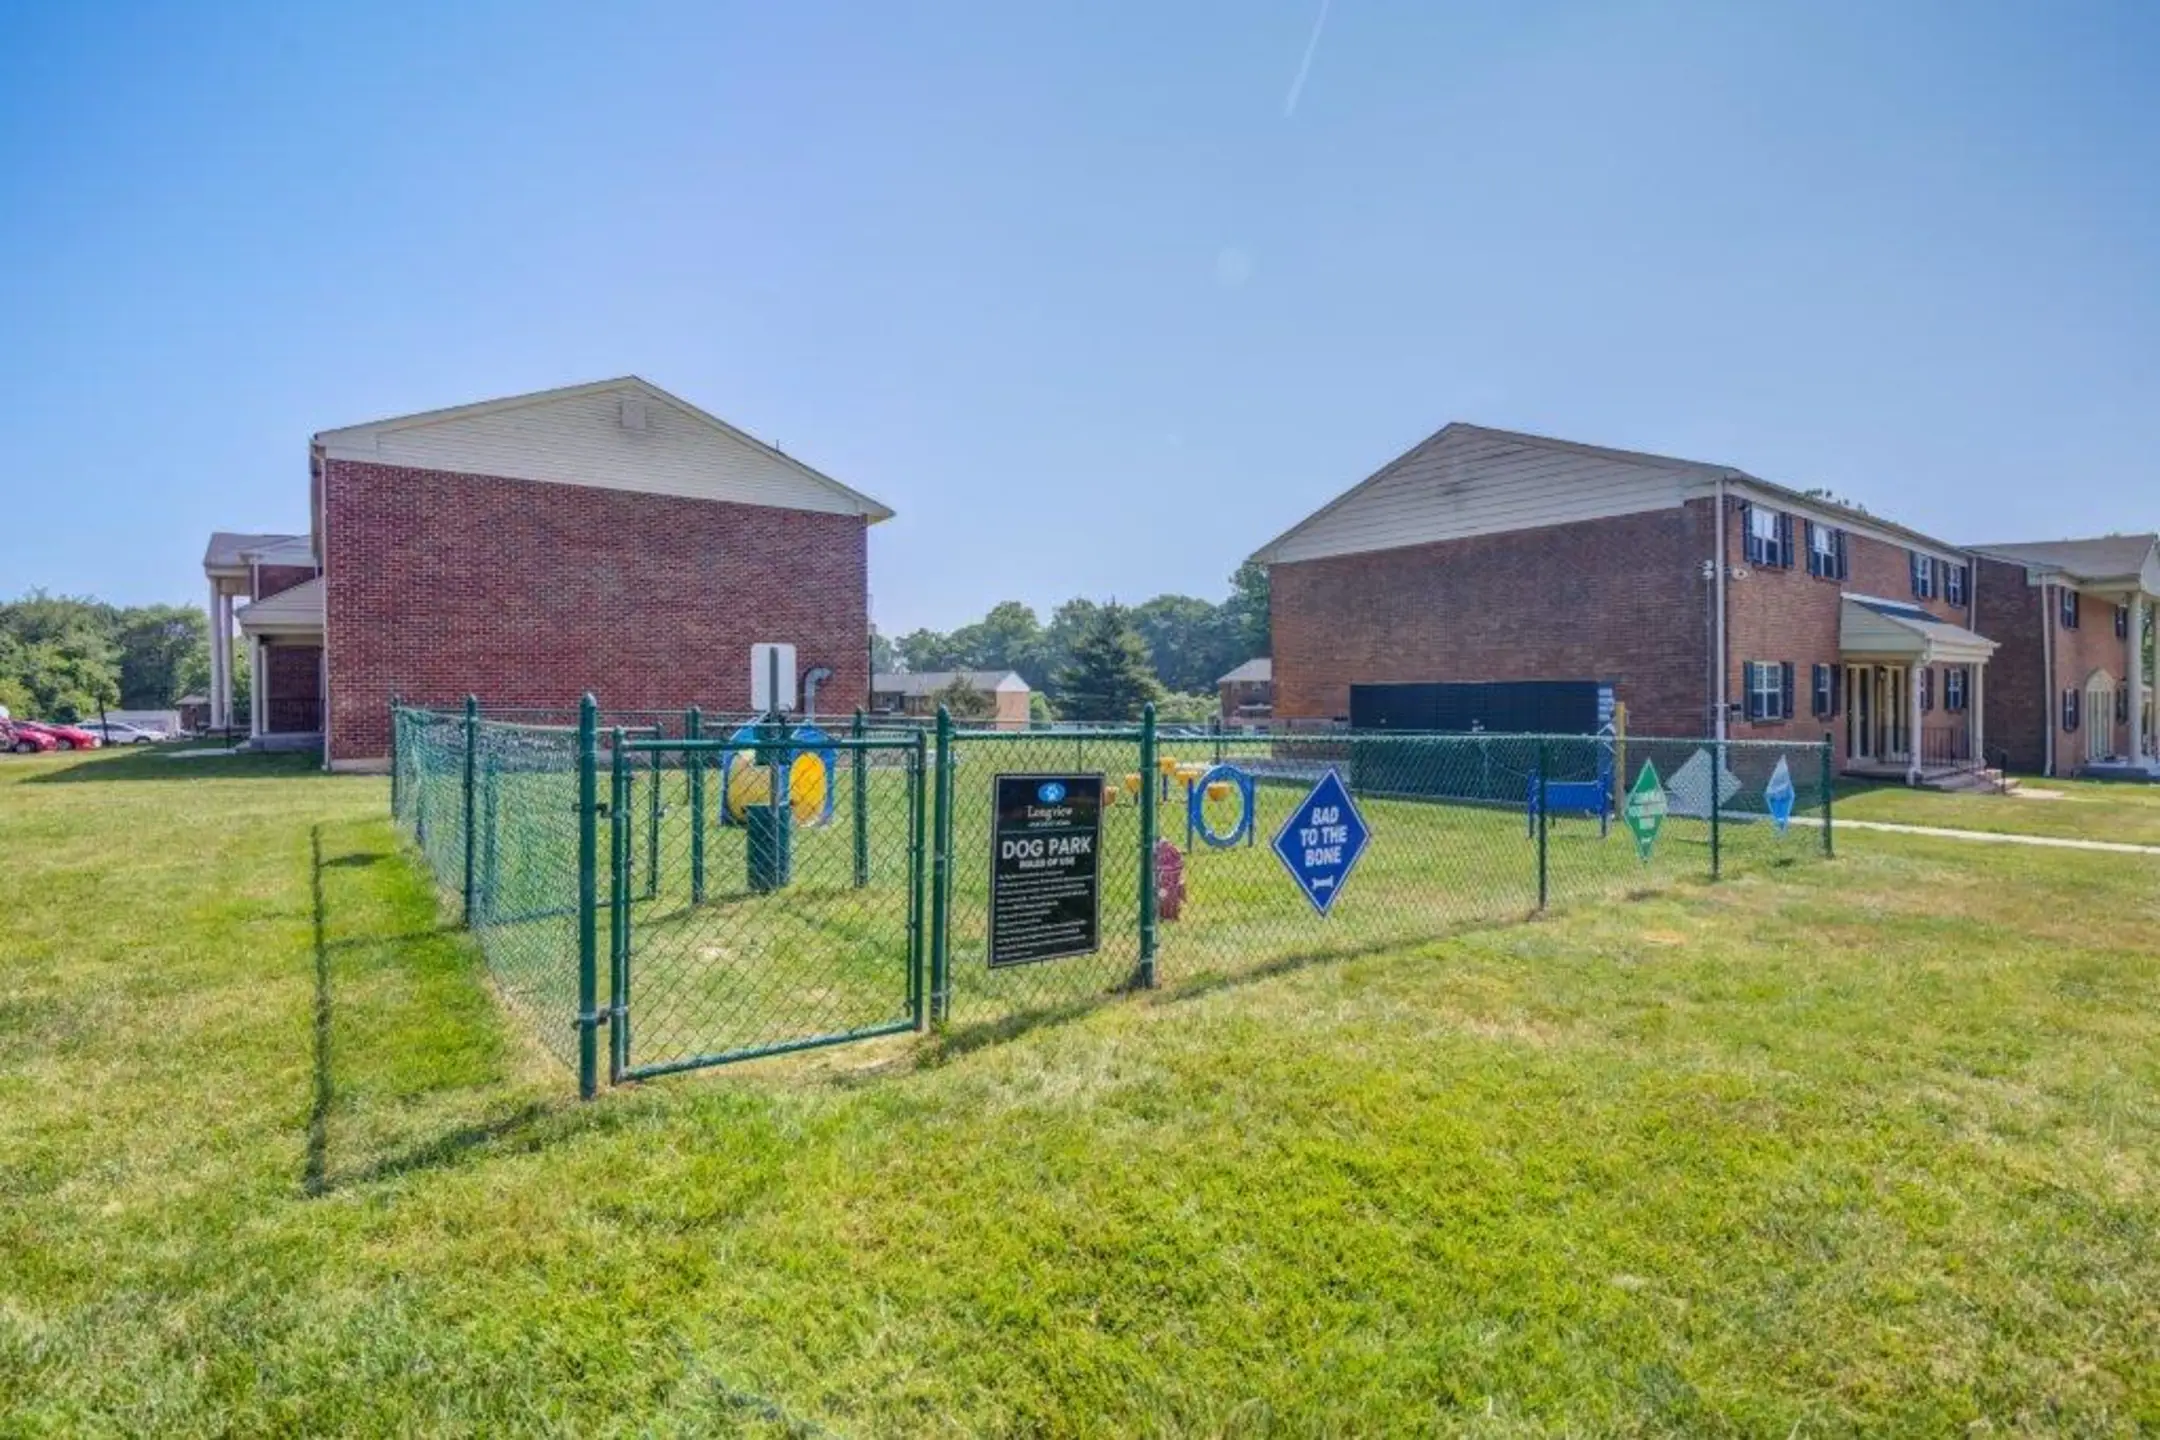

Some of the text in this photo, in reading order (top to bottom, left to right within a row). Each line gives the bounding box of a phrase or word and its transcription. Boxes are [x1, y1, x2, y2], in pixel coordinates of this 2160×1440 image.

[1312, 806, 1339, 825] BAD
[1300, 825, 1348, 847] TO THE
[1003, 836, 1092, 859] DOG PARK
[1305, 846, 1341, 867] BONE
